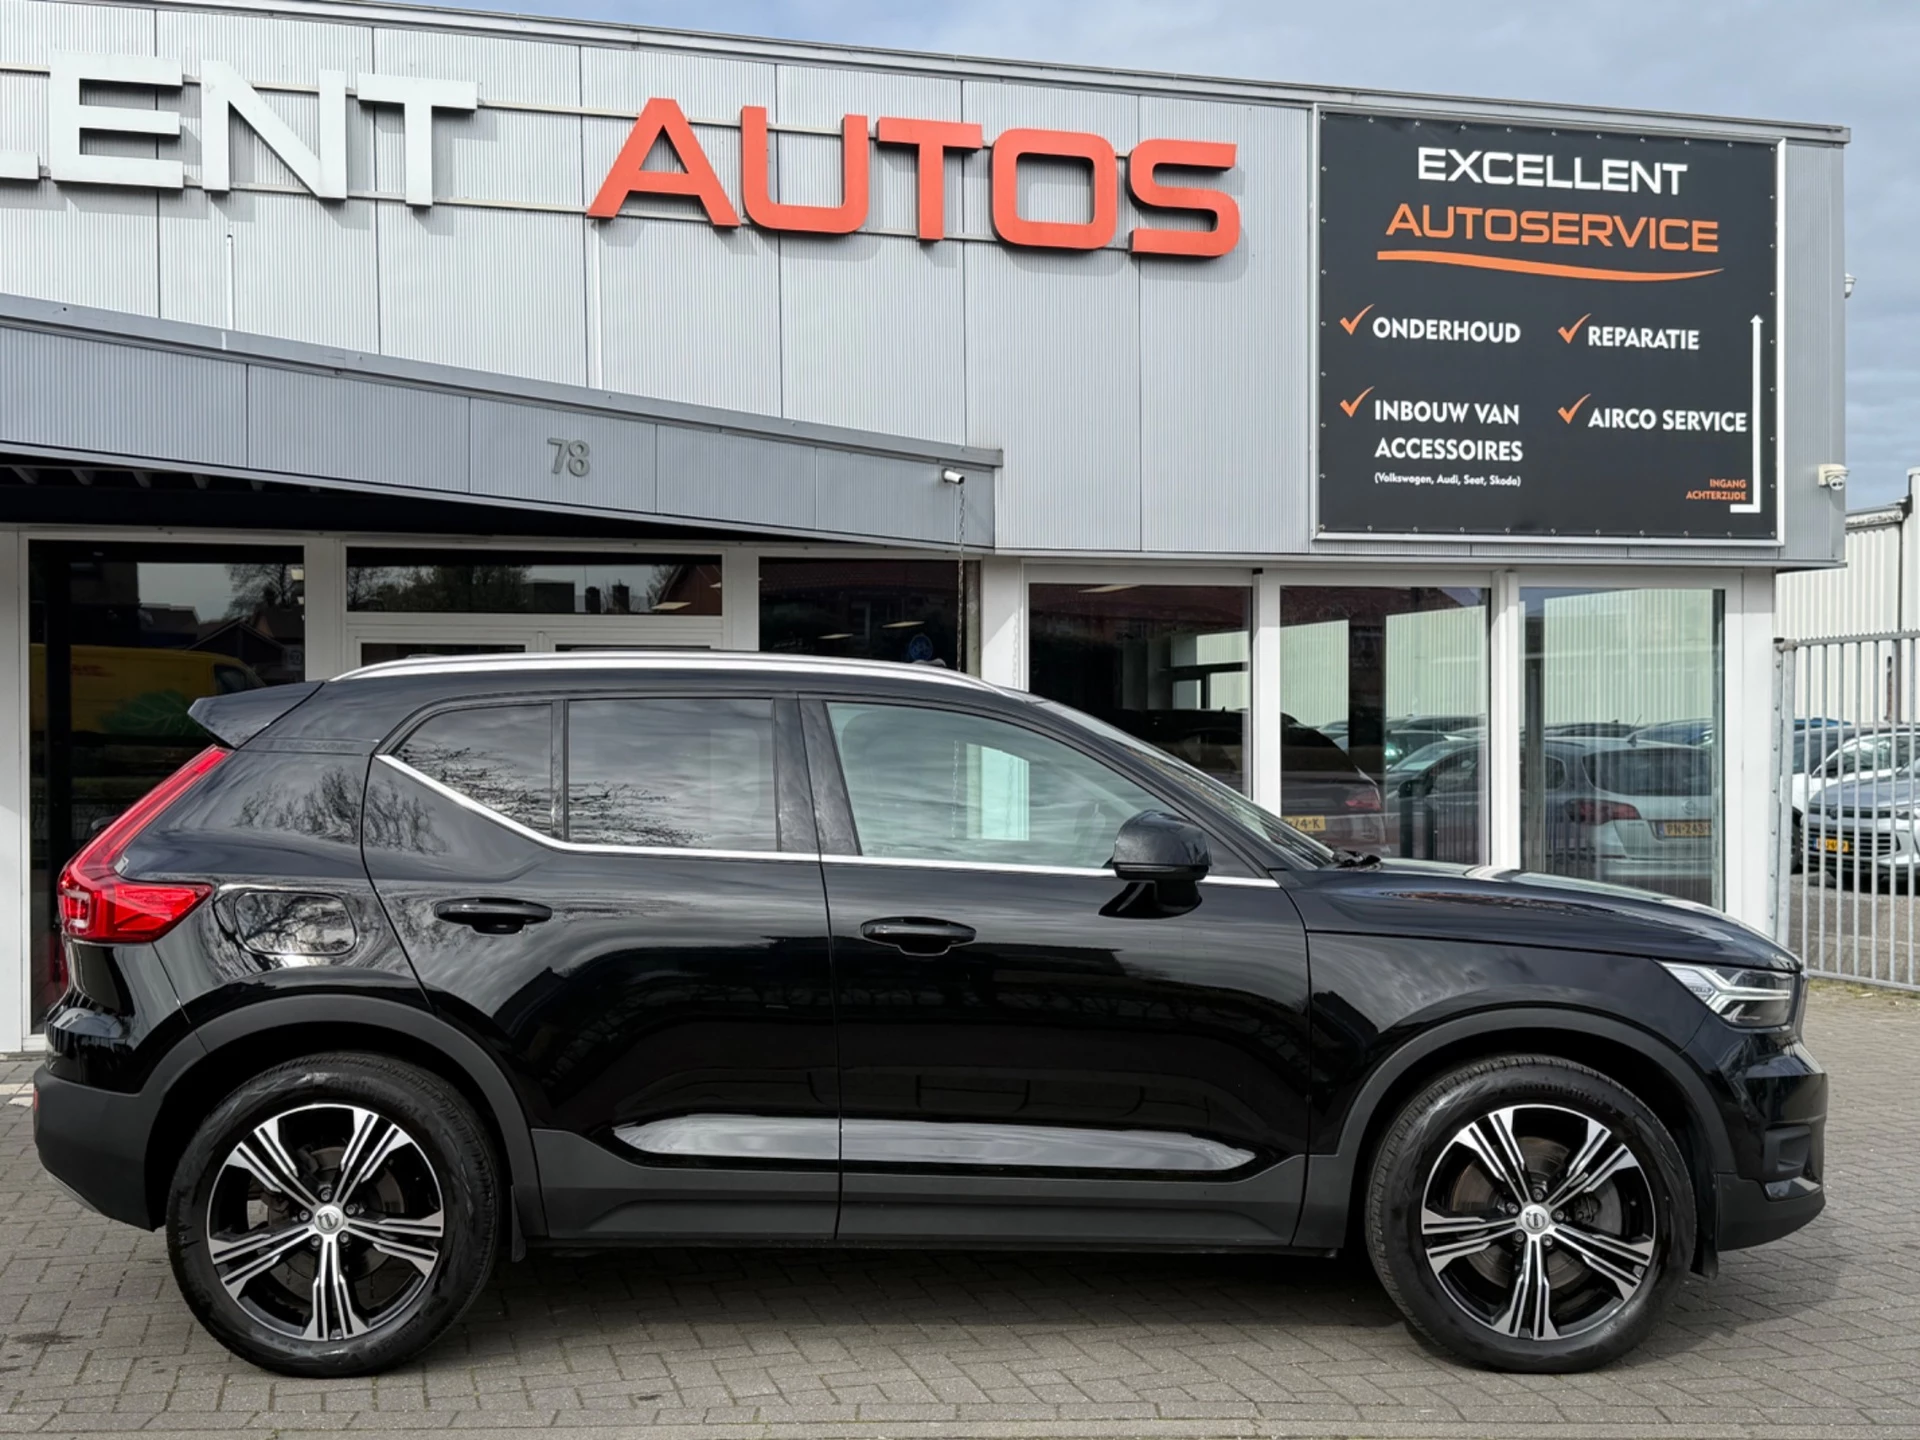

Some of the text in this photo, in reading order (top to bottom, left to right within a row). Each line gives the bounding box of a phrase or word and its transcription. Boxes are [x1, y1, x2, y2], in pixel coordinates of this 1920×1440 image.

[586, 97, 1240, 258] AUTOS
[1418, 146, 1688, 195] EXCELLENT
[1386, 202, 1719, 253] AUTOSERVICE
[1372, 316, 1522, 343] ONDERHOUD
[1588, 325, 1700, 350] REPARATIE
[1374, 399, 1520, 425] INBOUW VAN
[1588, 408, 1748, 432] AIRCO SERVICE
[546, 437, 591, 478] 78
[1374, 437, 1524, 462] ACCESSOIRES
[1374, 472, 1521, 487] (Volkswagen, Audi, Seat, Skoda)
[1709, 478, 1747, 489] INGANG
[1685, 490, 1747, 501] ACHTERZIJDE
